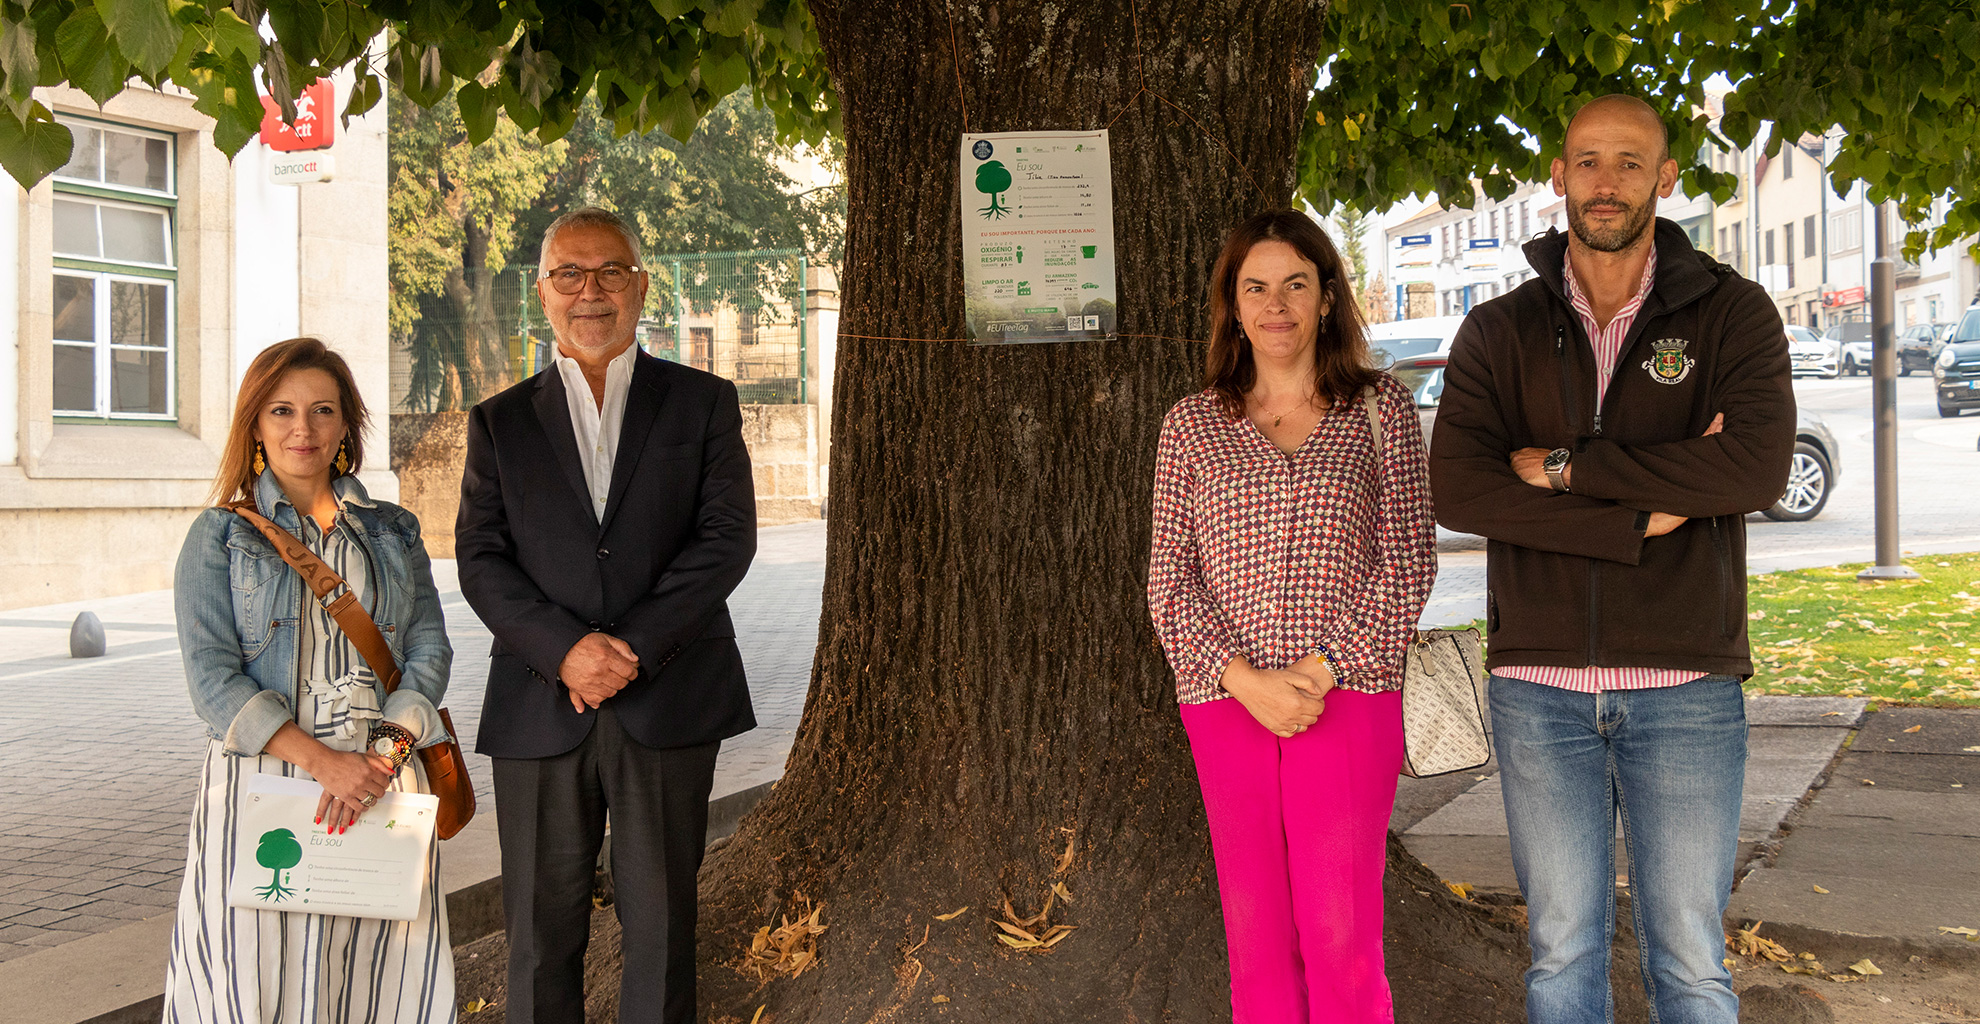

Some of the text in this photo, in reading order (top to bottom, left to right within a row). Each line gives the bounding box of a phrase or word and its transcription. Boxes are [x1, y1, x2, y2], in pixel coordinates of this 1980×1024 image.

[294, 122, 312, 137] ctt
[274, 162, 317, 176] bancoctt
[1016, 163, 1043, 171] Eu sou
[986, 323, 1029, 333] #EUTreeTag
[310, 834, 343, 847] Eu sou
